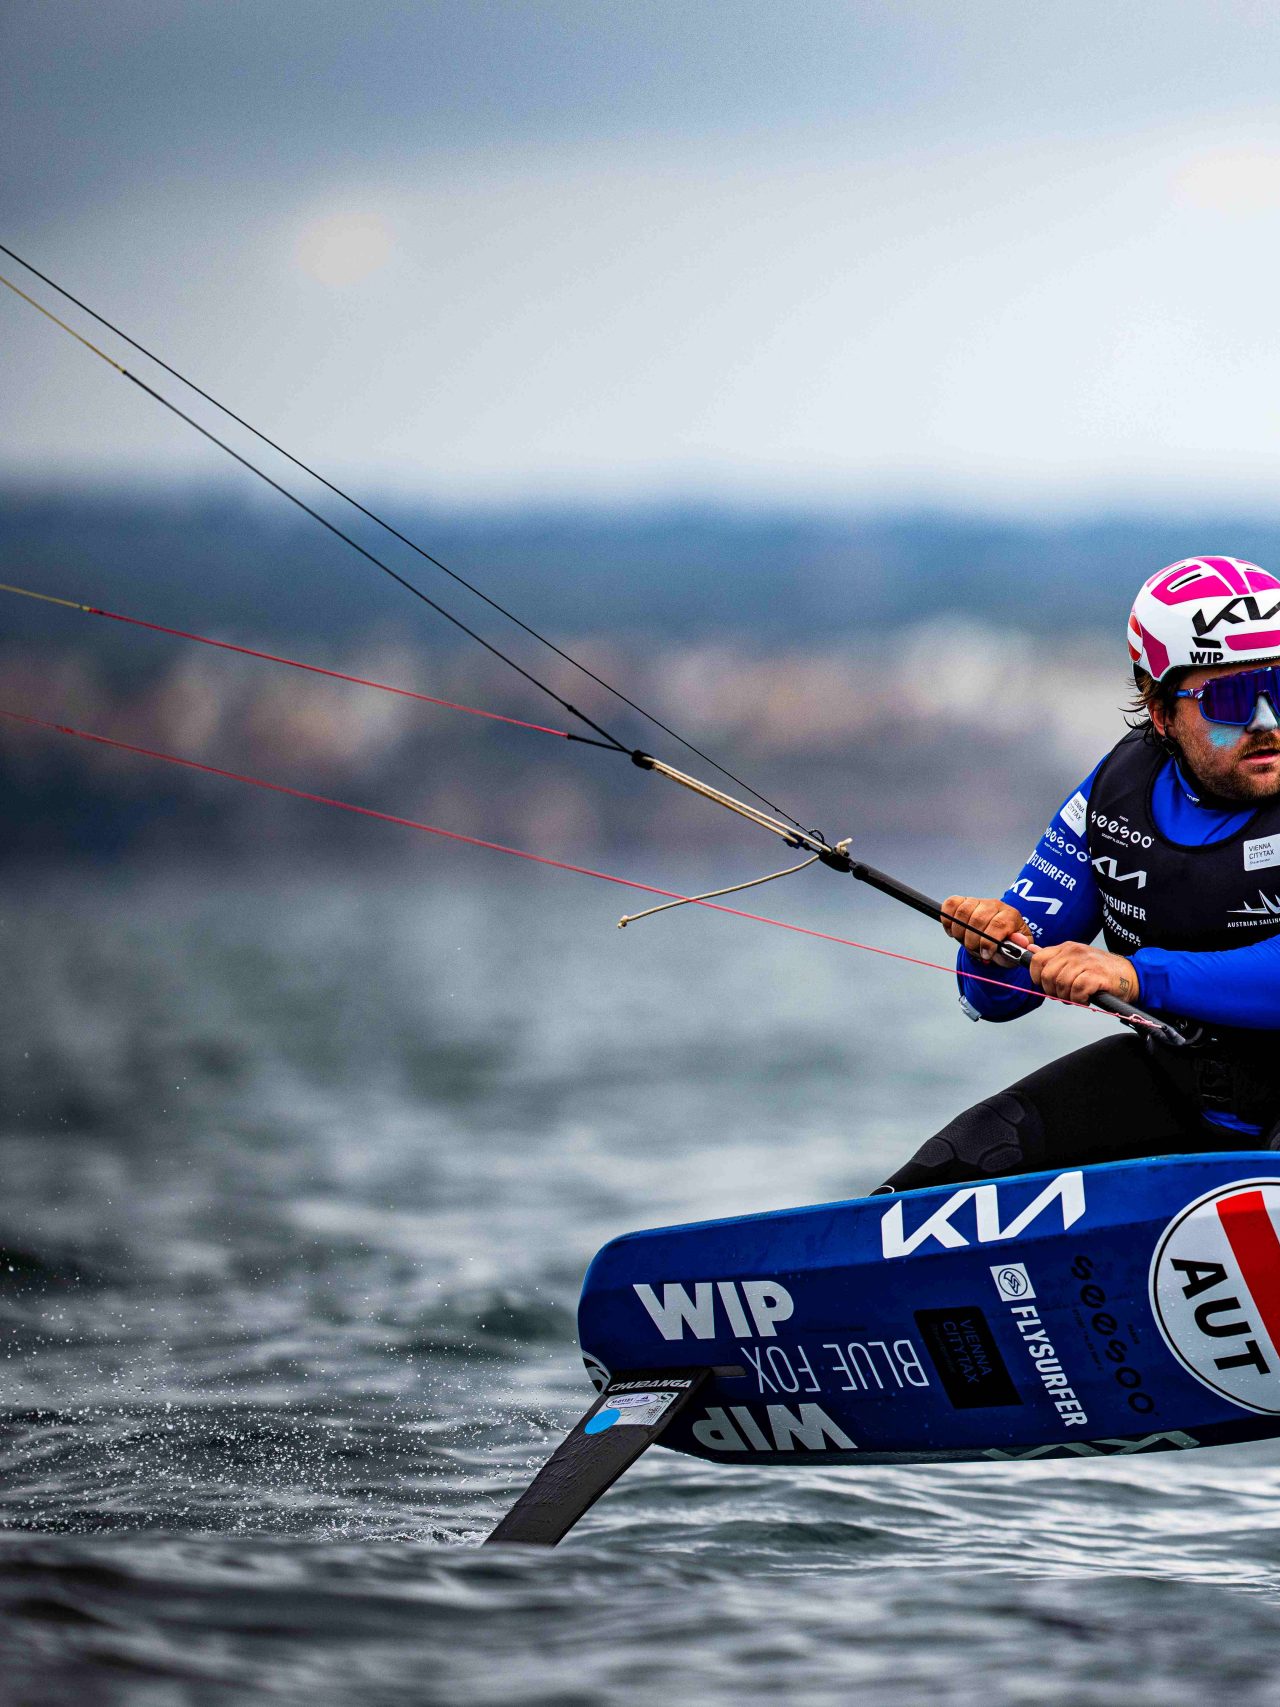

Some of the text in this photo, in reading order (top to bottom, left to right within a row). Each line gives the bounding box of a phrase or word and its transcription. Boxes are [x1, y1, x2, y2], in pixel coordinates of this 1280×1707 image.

[1190, 651, 1224, 664] WIP
[1248, 842, 1272, 852] VIENNA
[1248, 849, 1275, 860] CITYTAX
[1227, 920, 1258, 928] AUSTRIAN
[880, 1170, 1086, 1259] KIA
[632, 1280, 794, 1341] WIP
[1170, 1258, 1271, 1375] AUT
[741, 1345, 821, 1394] FOX
[823, 1340, 930, 1391] BLUE
[943, 1321, 980, 1384] CITYTAX
[960, 1319, 992, 1377] VIENNA
[1010, 1305, 1088, 1427] FLYSURFER
[607, 1379, 692, 1392] CHUBANGA
[692, 1403, 858, 1450] WIP
